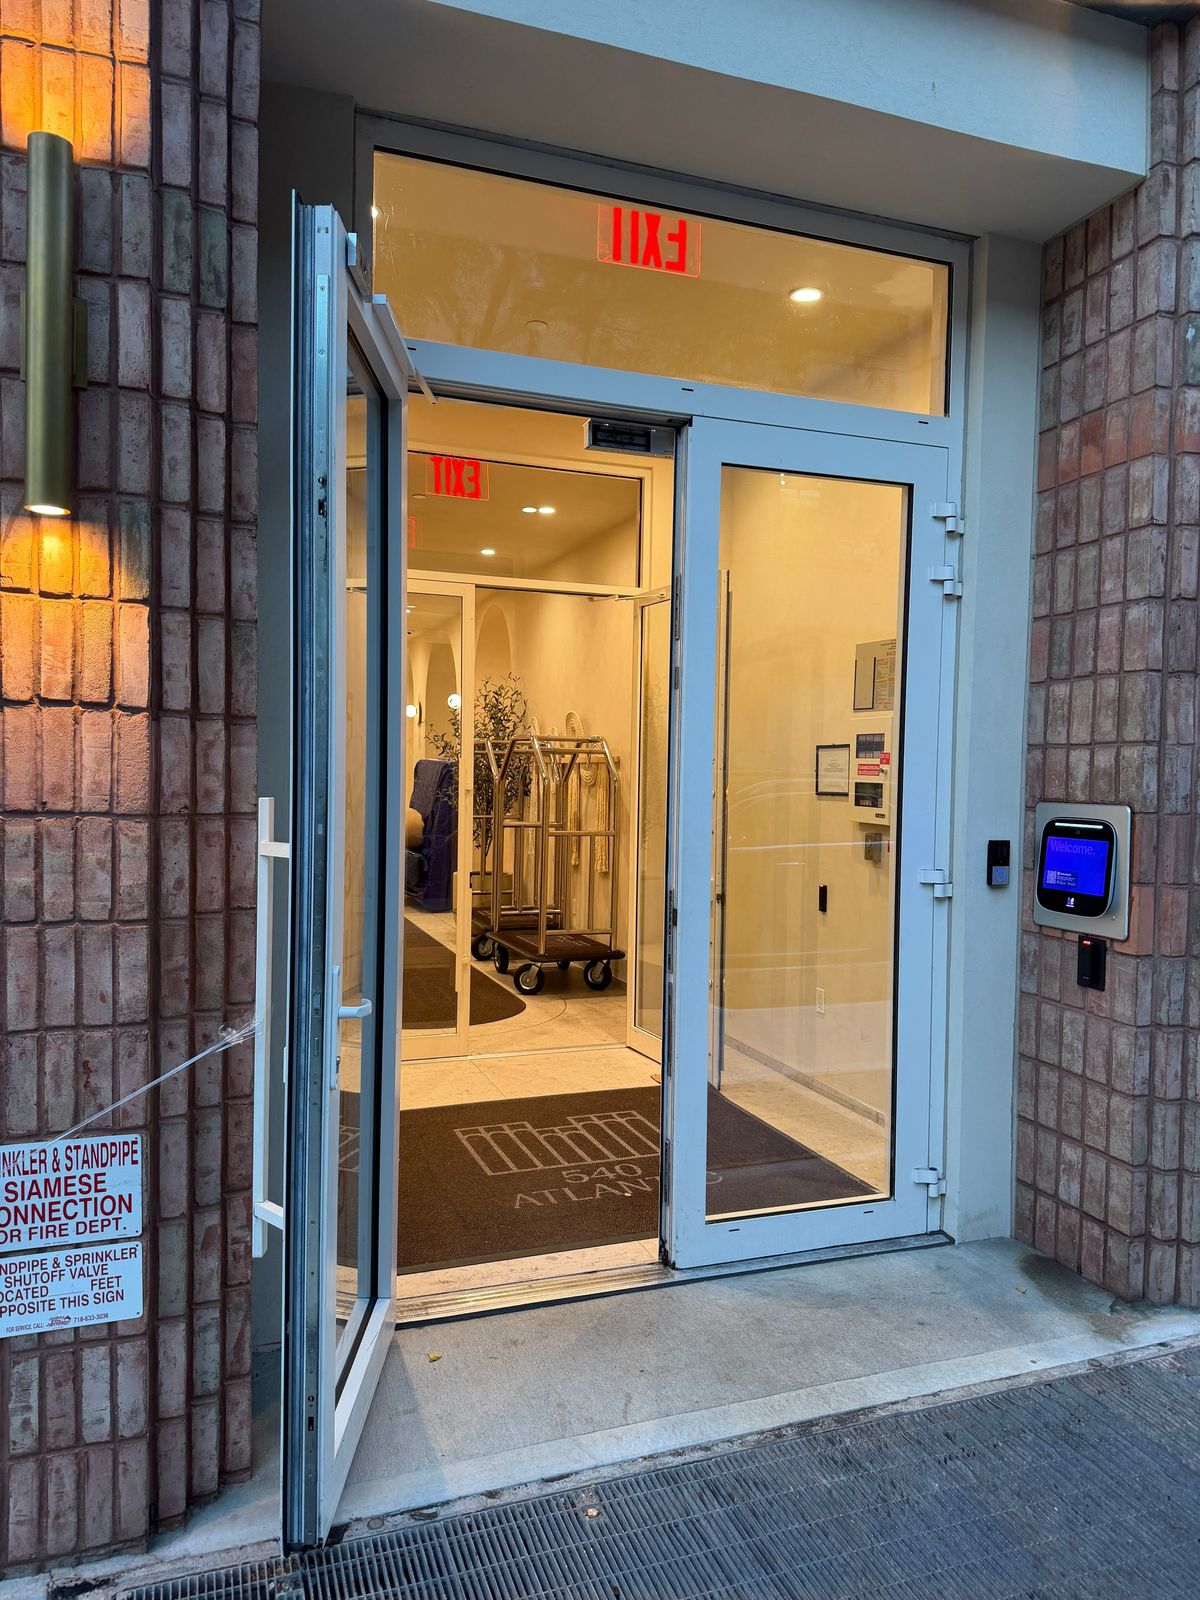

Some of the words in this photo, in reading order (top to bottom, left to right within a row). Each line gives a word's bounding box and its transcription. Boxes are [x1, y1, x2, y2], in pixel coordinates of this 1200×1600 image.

[0, 1148, 47, 1177] NKLER
[52, 1147, 60, 1173] &
[65, 1140, 138, 1172] STANDPIPE
[562, 1163, 643, 1184] 540
[4, 1172, 107, 1203] SIAMESE
[28, 1222, 69, 1241] FIRE
[75, 1217, 127, 1236] DEPT.
[52, 1257, 61, 1269] &
[65, 1247, 137, 1268] SPRINKLER
[4, 1269, 66, 1289] SHUTOFF
[69, 1263, 109, 1280] VALVE
[90, 1275, 122, 1291] FEET
[60, 1294, 89, 1309] THIS
[93, 1289, 124, 1305] SIGN
